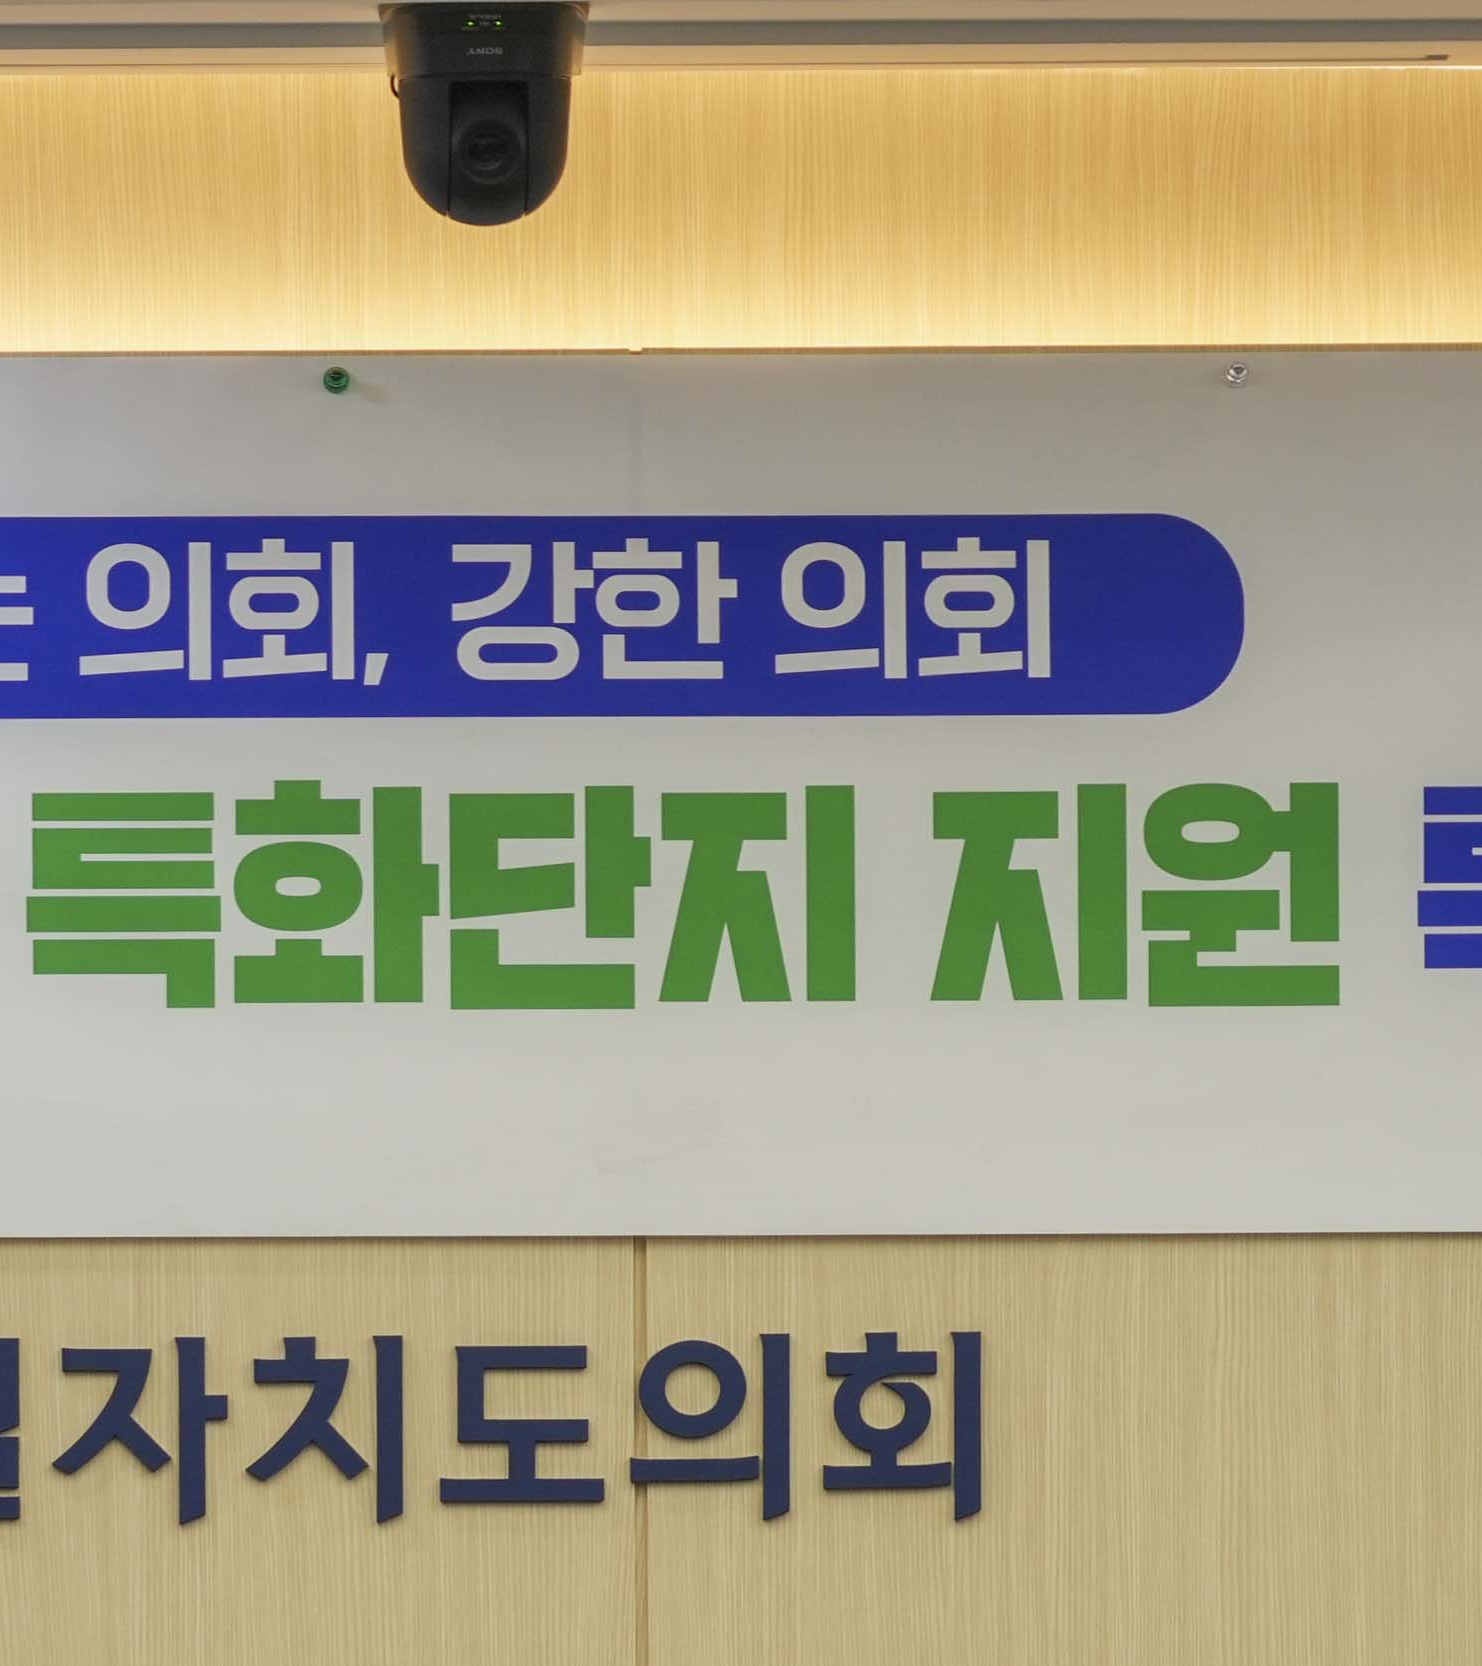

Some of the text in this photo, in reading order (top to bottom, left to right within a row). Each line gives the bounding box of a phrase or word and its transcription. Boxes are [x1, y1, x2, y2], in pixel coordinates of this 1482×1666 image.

[79, 538, 389, 686] 의회,
[451, 538, 738, 681] 강한
[775, 537, 1051, 679] 의회
[25, 779, 857, 1011] 특화단지
[929, 781, 1341, 1008] 지원
